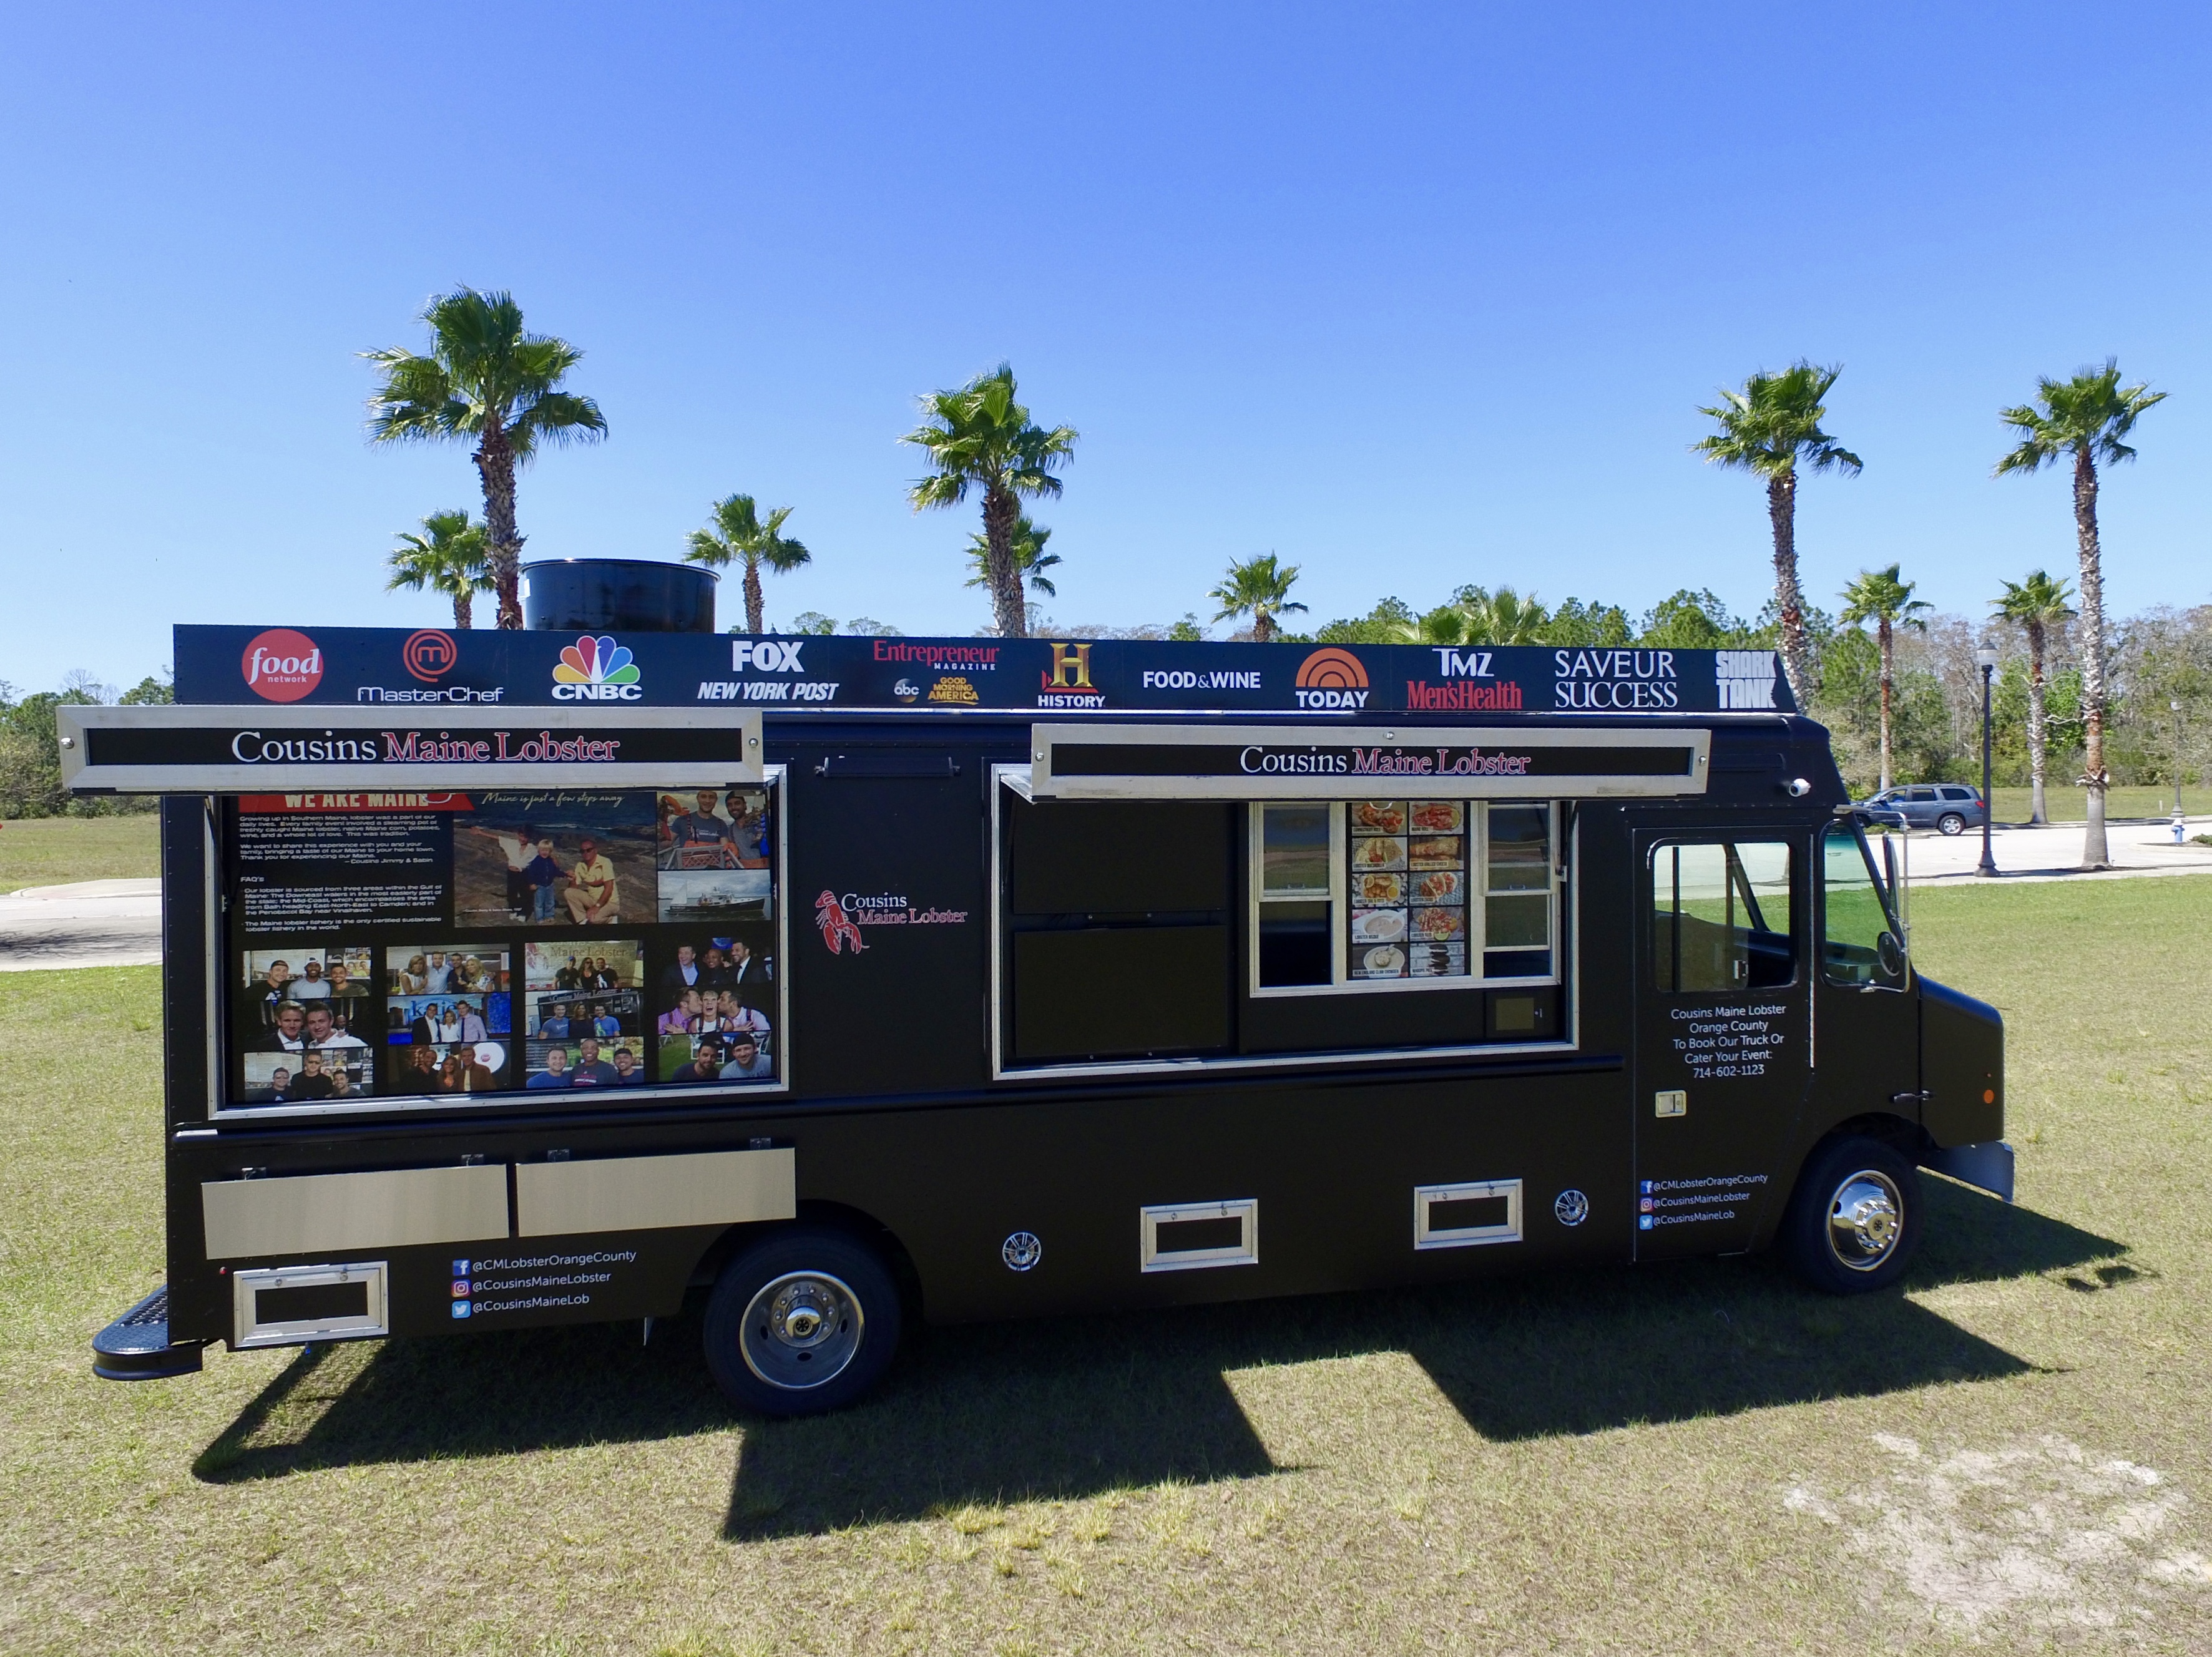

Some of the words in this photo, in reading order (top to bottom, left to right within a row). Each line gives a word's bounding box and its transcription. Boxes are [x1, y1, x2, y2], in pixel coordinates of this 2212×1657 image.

[733, 641, 805, 672] FOX
[874, 640, 999, 667] Entrepreneur
[1432, 648, 1495, 677] TMZ
[248, 647, 320, 685] food
[1555, 650, 1677, 678] SAVEUR
[1716, 651, 1776, 678] SHARK
[357, 687, 503, 703] MasterChef
[551, 684, 642, 700] CNBC
[697, 682, 741, 699] NEW
[743, 682, 791, 700] YORK
[791, 683, 839, 700] POST
[894, 683, 919, 695] abc
[927, 691, 979, 700] AMERICA
[1555, 681, 1678, 708] SUCCESS
[1716, 678, 1777, 708] TANK
[1038, 695, 1105, 707] HISTORY
[1295, 690, 1369, 708] TODAY
[232, 731, 377, 762] Cousins
[381, 731, 490, 762] Maine
[495, 731, 620, 762] Lobster
[1240, 746, 1348, 773] Cousins
[1351, 748, 1432, 775] Maine
[1436, 748, 1532, 775] Lobster
[482, 793, 518, 804] Maine
[524, 793, 549, 811] just
[556, 792, 575, 807] few
[577, 792, 598, 806] steps
[600, 796, 624, 808] away
[841, 892, 907, 911] Cousins
[857, 909, 908, 925] Maine
[909, 907, 967, 924] Lobster
[551, 947, 585, 956] Maine
[587, 946, 625, 956] Lobster
[1671, 1008, 1712, 1019] Cousins
[1715, 1007, 1746, 1017] Maine
[1748, 1005, 1786, 1015] Lobster
[1690, 1023, 1728, 1034] Orange
[1730, 1021, 1768, 1031] County
[1673, 1039, 1686, 1049] To
[1689, 1038, 1715, 1048] Book
[1718, 1037, 1738, 1047] Our
[1740, 1034, 1768, 1045] Truck
[1771, 1034, 1784, 1044] Or
[1685, 1053, 1713, 1064] Cater
[1716, 1052, 1738, 1062] Your
[1742, 1050, 1773, 1060] Event:
[1693, 1065, 1764, 1078] 714-602-1123
[1653, 1174, 1768, 1191] @CMLobsterOrangeCounty
[1653, 1191, 1750, 1209] @CousinsMaineLobster
[1653, 1210, 1735, 1226] @CousinsMaineLob
[472, 1251, 637, 1272] @CMLobsterOrangeCounty
[472, 1271, 611, 1293] @CousinsMaineLobster
[472, 1293, 589, 1313] @CousinsMaineLob
